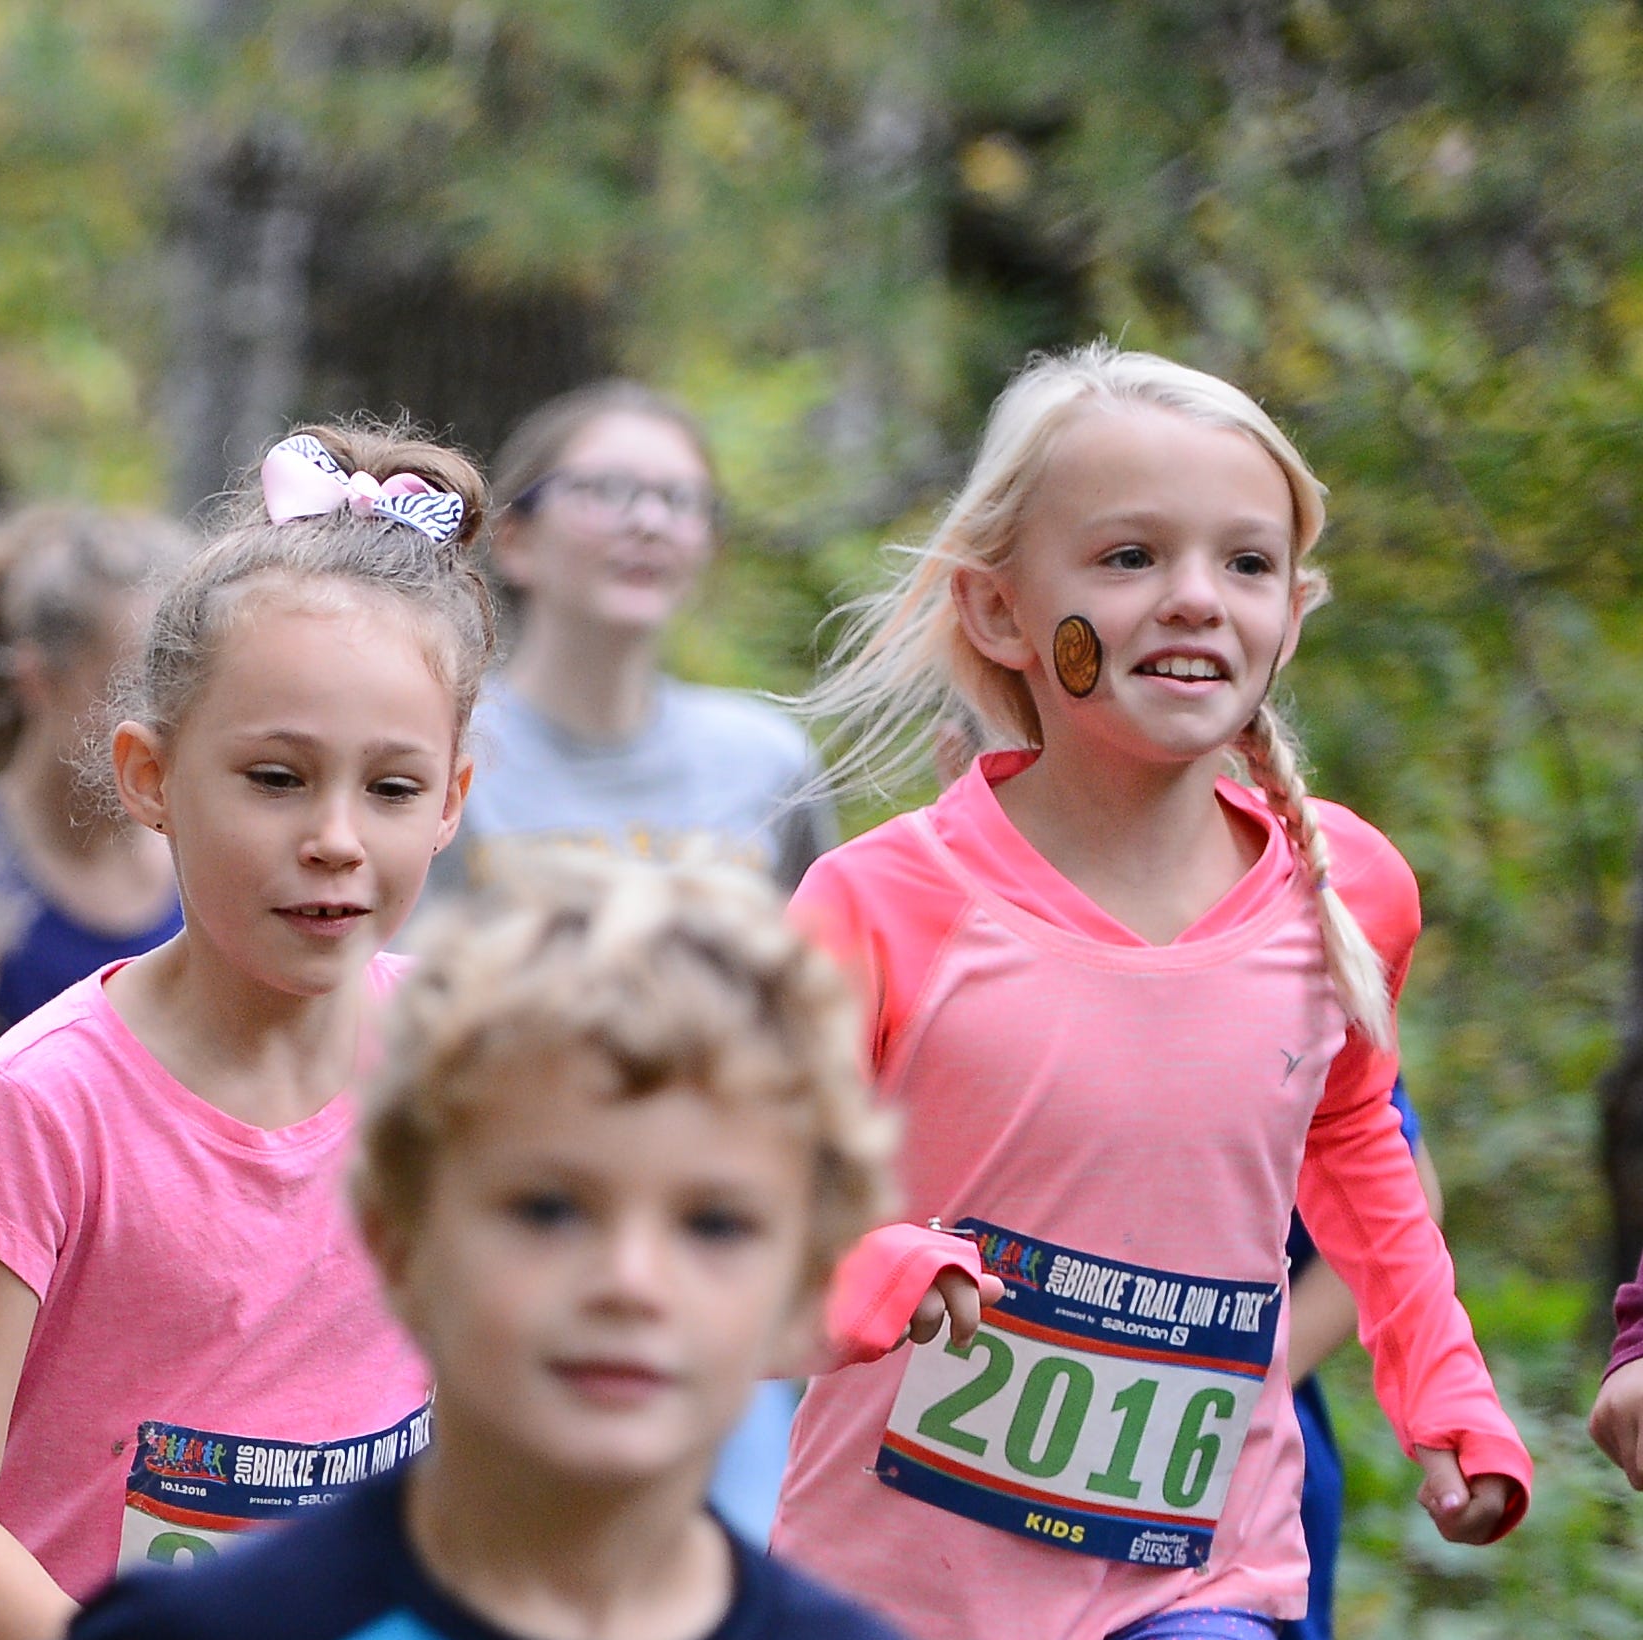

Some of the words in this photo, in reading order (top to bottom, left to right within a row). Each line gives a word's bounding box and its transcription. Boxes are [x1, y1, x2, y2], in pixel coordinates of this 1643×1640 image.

[1063, 1260, 1132, 1313] BIRKIE
[1128, 1275, 1182, 1324] TRAIL
[1179, 1285, 1219, 1328] RUN
[1218, 1294, 1231, 1326] &
[1230, 1291, 1266, 1333] TREK
[917, 1330, 1236, 1509] 2016
[234, 1445, 255, 1485] 2016
[251, 1447, 317, 1488] BIRKIE
[321, 1443, 368, 1485] TRAIL
[371, 1431, 398, 1475] RUN
[400, 1430, 408, 1459] &
[160, 1481, 208, 1498] 10.1.2016
[1023, 1511, 1085, 1543] KIDS
